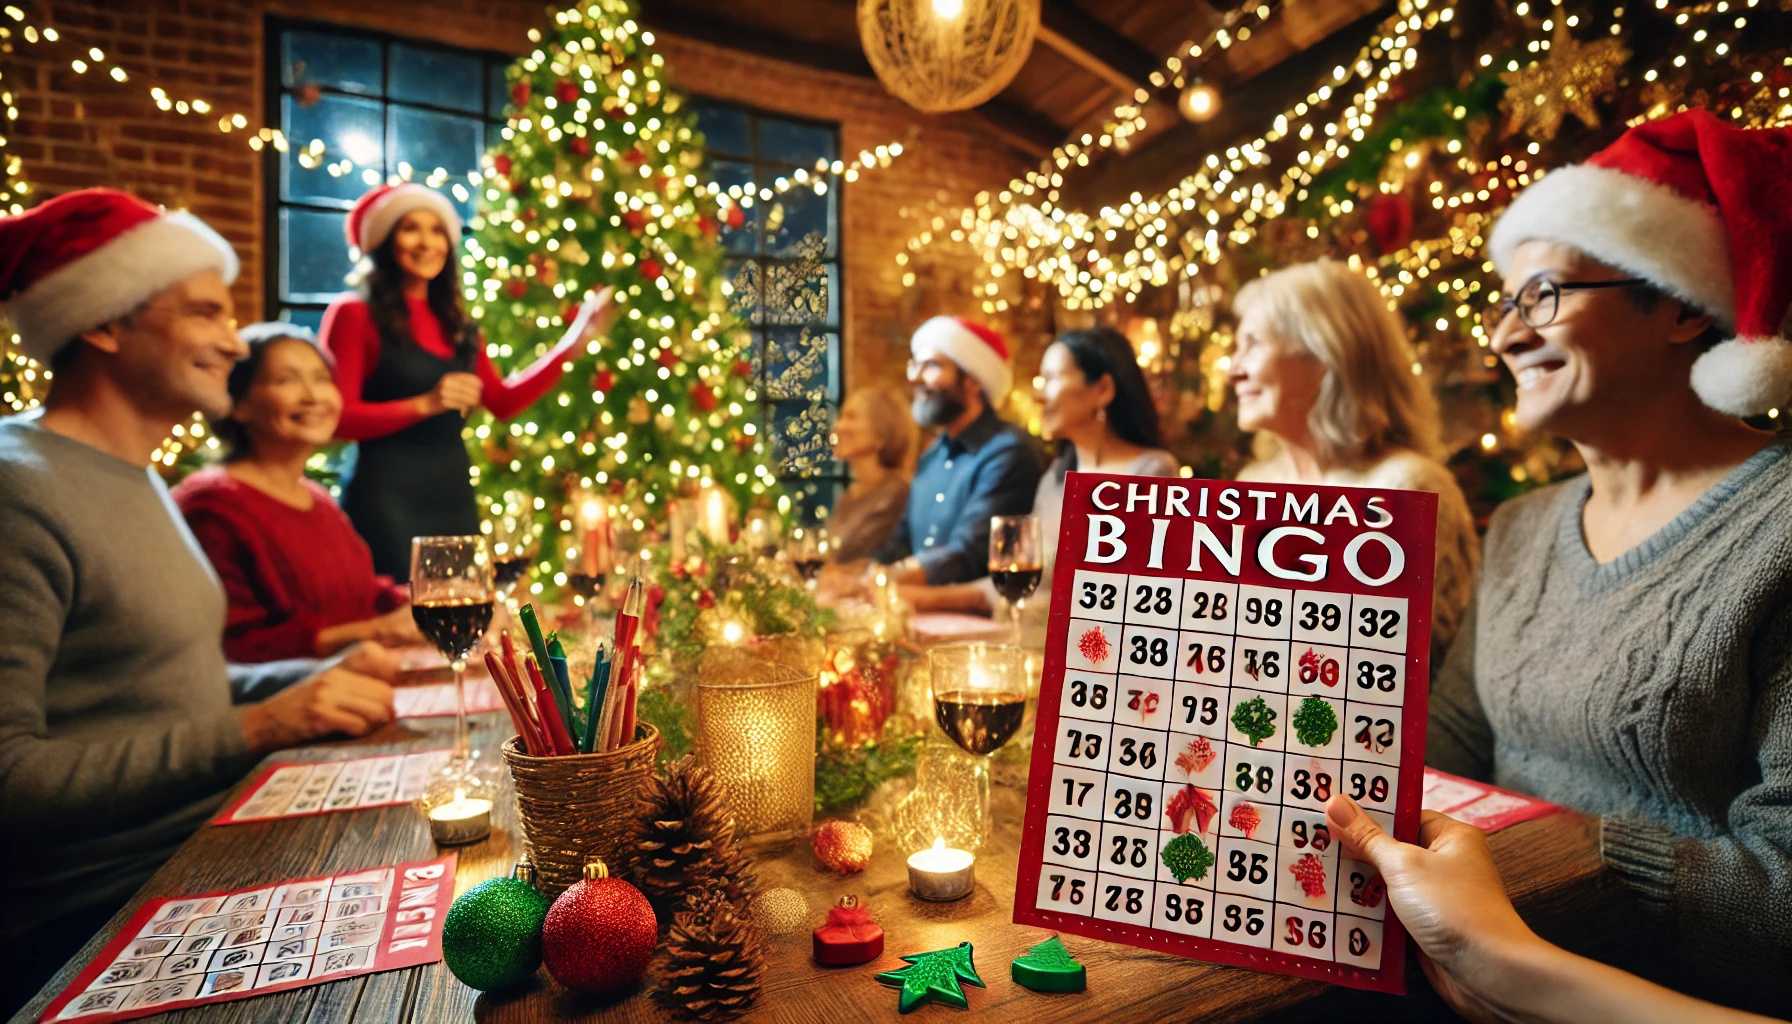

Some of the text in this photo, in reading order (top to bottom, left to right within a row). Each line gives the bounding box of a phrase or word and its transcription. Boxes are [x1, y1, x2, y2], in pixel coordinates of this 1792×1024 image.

[1091, 481, 1393, 529] CHRISTMAS
[1084, 513, 1406, 587] BINGO
[1245, 597, 1282, 627] 98
[1358, 607, 1400, 638] 32
[1062, 778, 1094, 807] 17
[1291, 769, 1332, 802] 38
